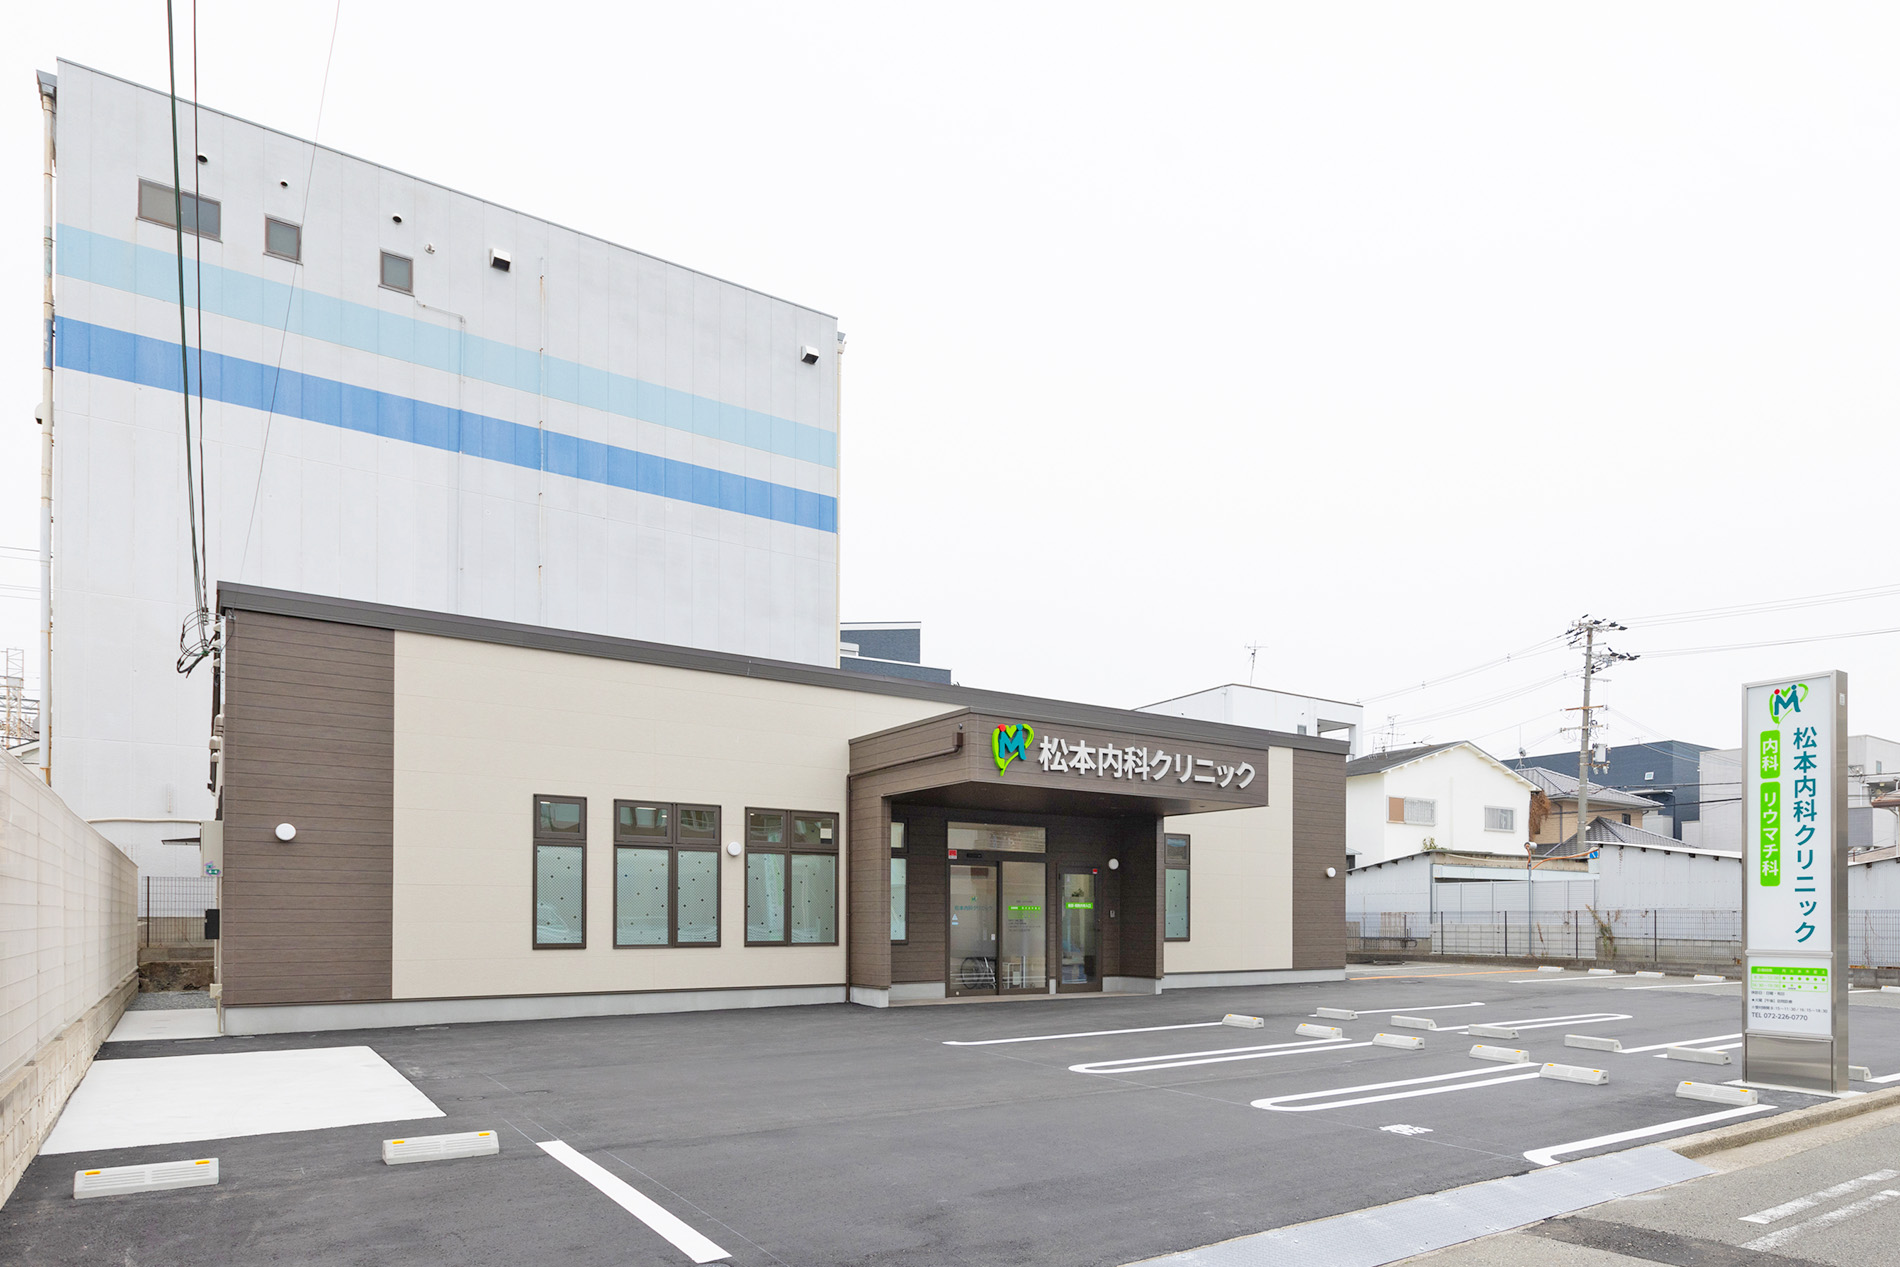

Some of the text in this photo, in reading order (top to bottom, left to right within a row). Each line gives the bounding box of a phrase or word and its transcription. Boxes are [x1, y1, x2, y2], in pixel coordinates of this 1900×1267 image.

[1037, 735, 1256, 789] 松本内科クリニック
[1761, 738, 1779, 772] 内科
[1761, 792, 1779, 876] リウマチ科
[1793, 726, 1817, 943] 松本内科クリニック
[1763, 1012, 1808, 1021] 072-226-0770
